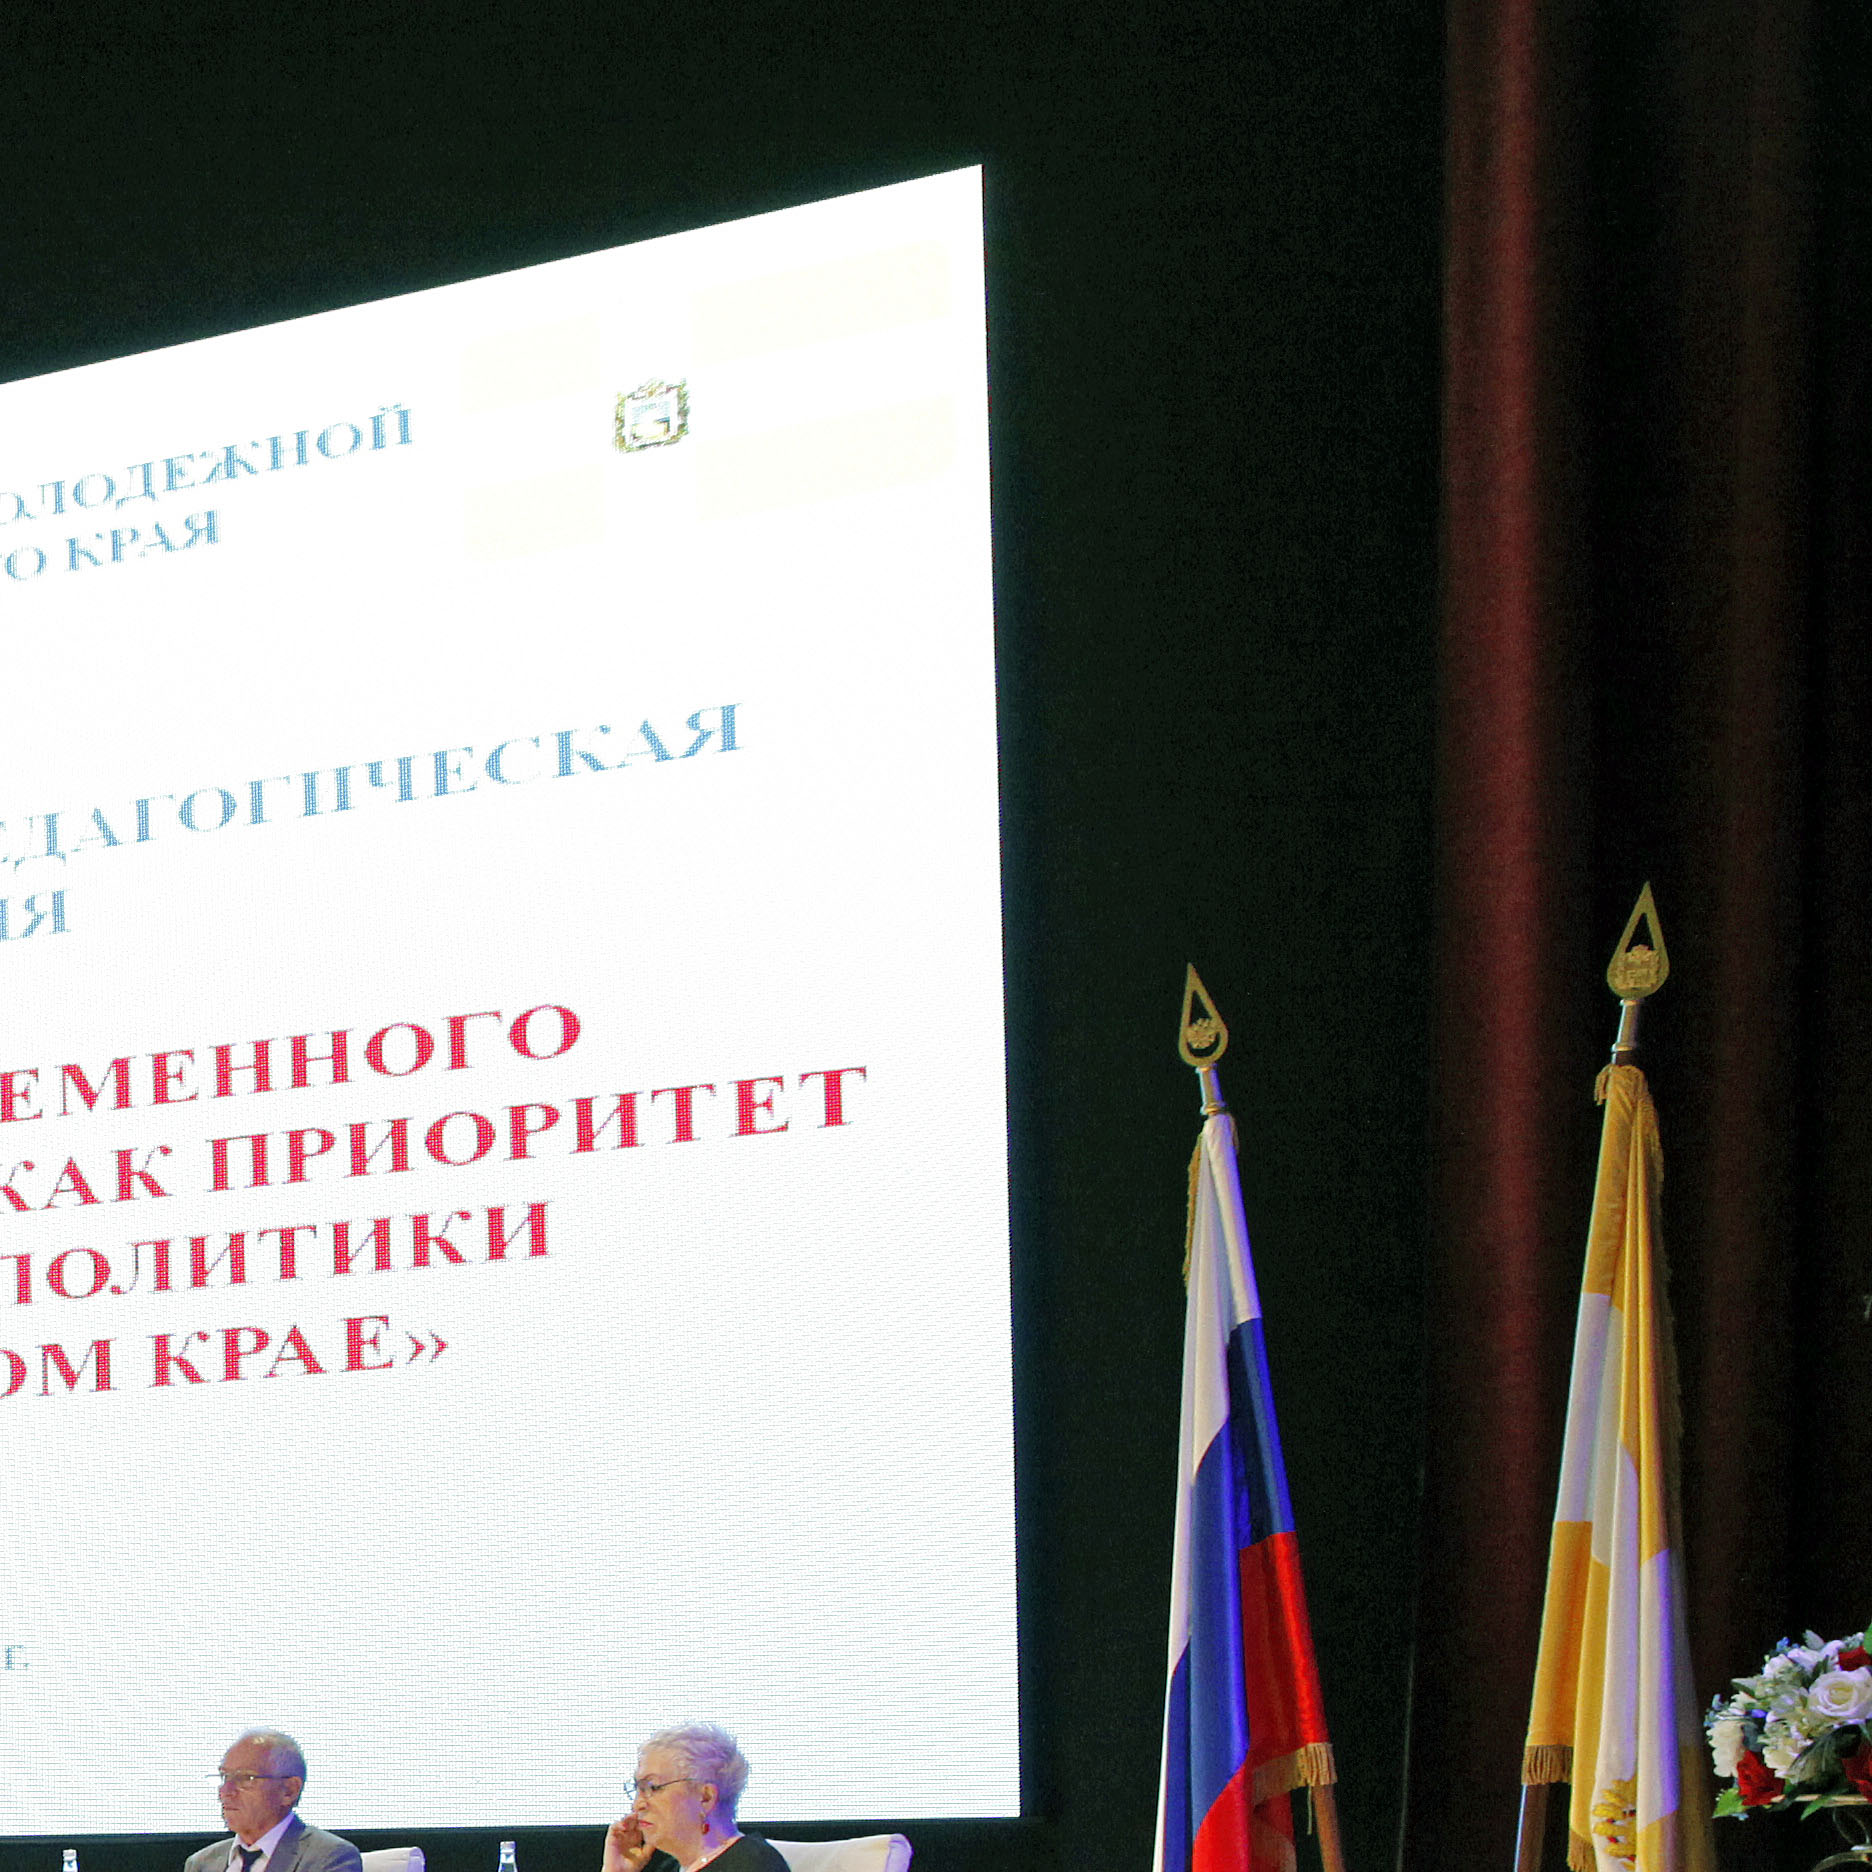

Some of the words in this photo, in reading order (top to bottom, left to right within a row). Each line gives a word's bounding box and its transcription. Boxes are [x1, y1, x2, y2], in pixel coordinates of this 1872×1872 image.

[64, 508, 223, 572] КРАЯ
[205, 1065, 868, 1194] ПРИОРИТЕТ
[148, 1314, 449, 1390] КРАЕ»
